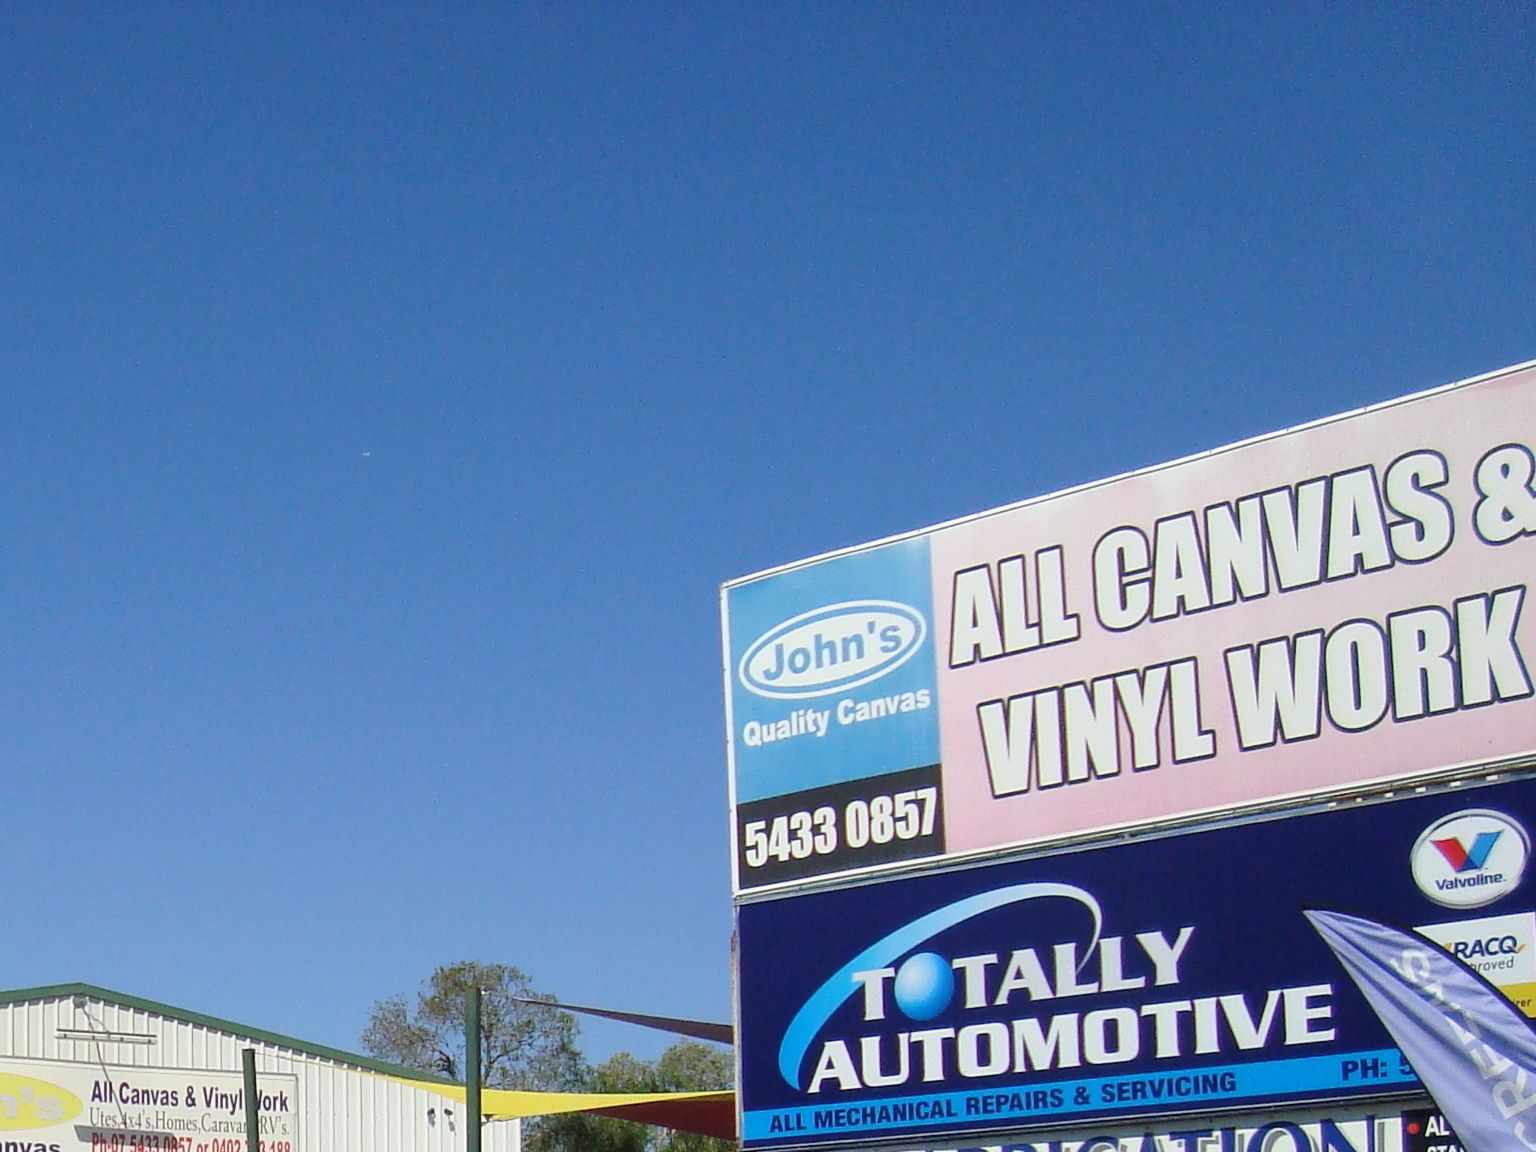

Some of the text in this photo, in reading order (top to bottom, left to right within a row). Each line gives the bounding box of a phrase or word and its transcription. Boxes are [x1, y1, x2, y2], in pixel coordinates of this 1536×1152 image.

[949, 443, 1536, 670] ALL CANVAS &
[762, 620, 903, 681] John's
[743, 688, 931, 747] Quality Canvas
[977, 586, 1536, 799] VINYL WORK
[745, 787, 937, 868] 5433 0857
[1435, 873, 1503, 890] Valvoline
[1454, 935, 1519, 958] RACQ
[1470, 956, 1514, 972] roved
[806, 983, 1336, 1094] AUTOMOTIVE
[91, 1080, 113, 1103] All
[119, 1082, 179, 1107] Canvas
[185, 1085, 197, 1107] &
[203, 1086, 243, 1115] Vinyl
[769, 1111, 807, 1134] ALL
[814, 1099, 958, 1130] MECHANICAL
[966, 1088, 1064, 1116] REPAIRS
[1073, 1086, 1091, 1106] &
[1101, 1072, 1237, 1102] SERVICING
[1341, 1057, 1387, 1081] PH:
[1424, 1115, 1450, 1137] AL
